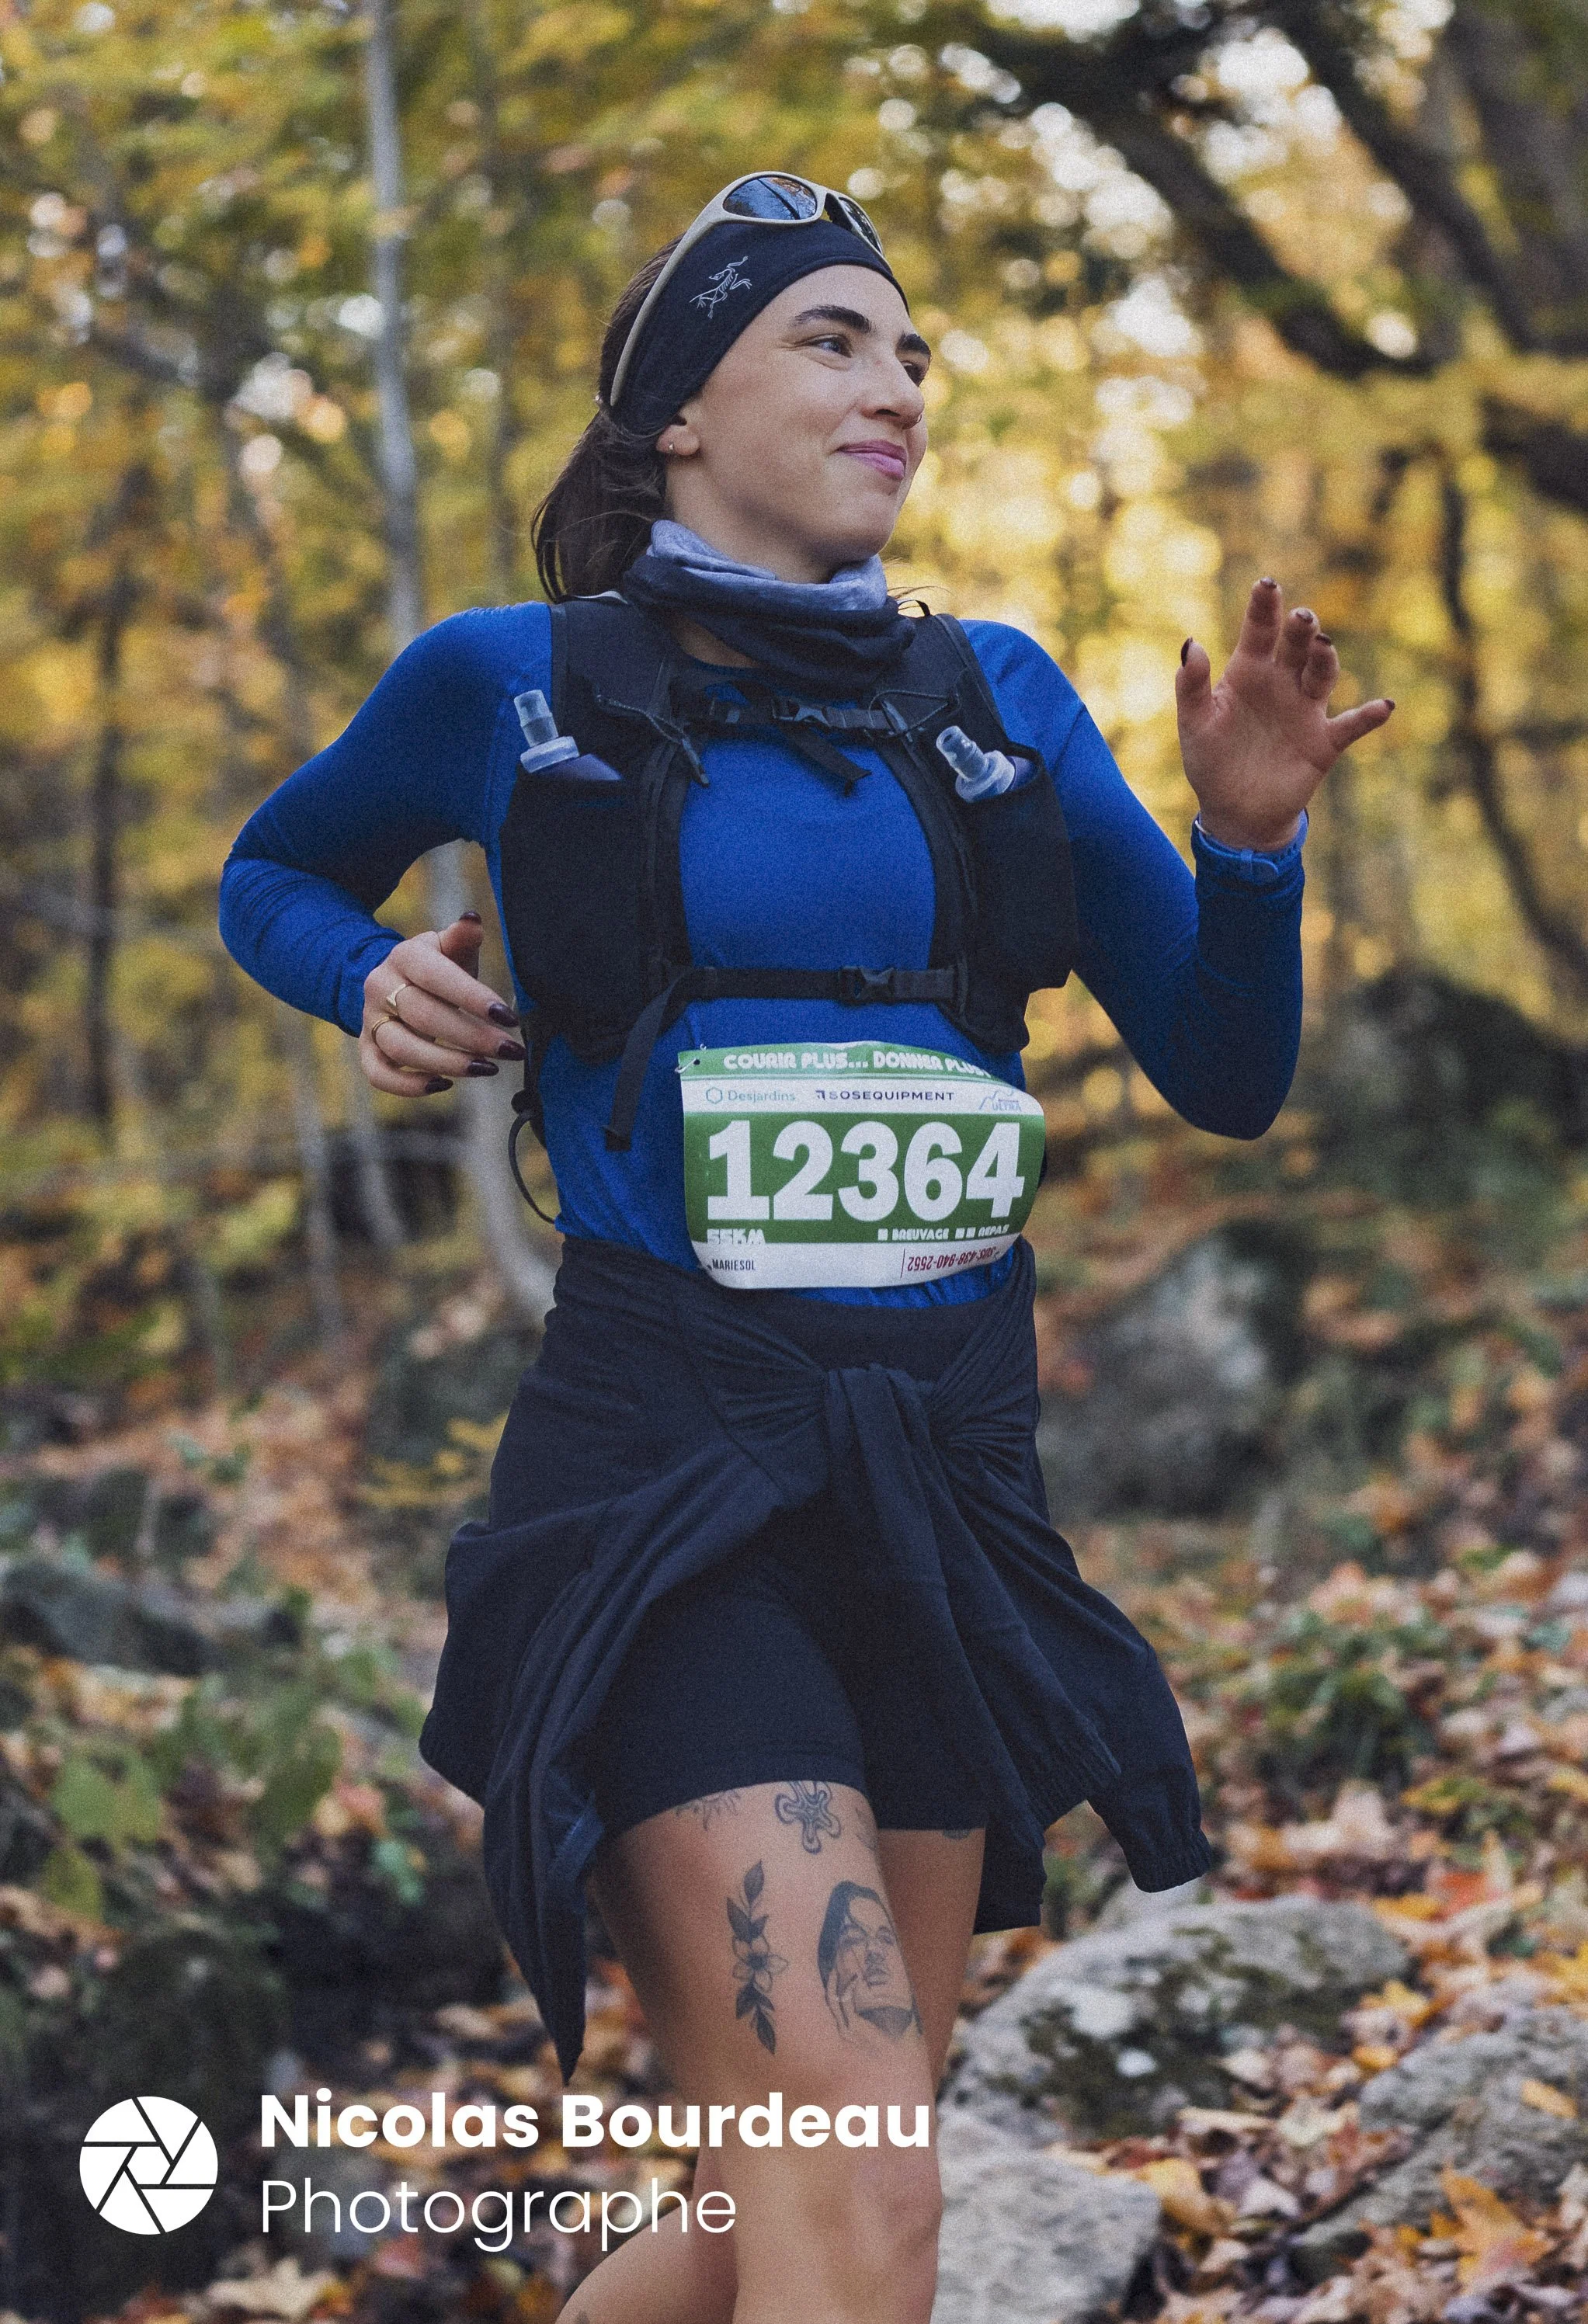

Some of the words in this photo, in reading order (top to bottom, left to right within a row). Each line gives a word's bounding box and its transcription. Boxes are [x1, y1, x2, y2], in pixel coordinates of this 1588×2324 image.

[723, 1052, 797, 1069] COURIR
[801, 1051, 868, 1069] PLUS...
[873, 1051, 943, 1071] DONNER
[728, 1089, 796, 1103] Desjardins
[707, 1120, 1026, 1222] 12364
[707, 1228, 766, 1245] 55KM
[891, 1228, 950, 1241] BREUVAGE
[978, 1224, 1010, 1238] REPAS
[711, 1258, 756, 1271] MARIESOL
